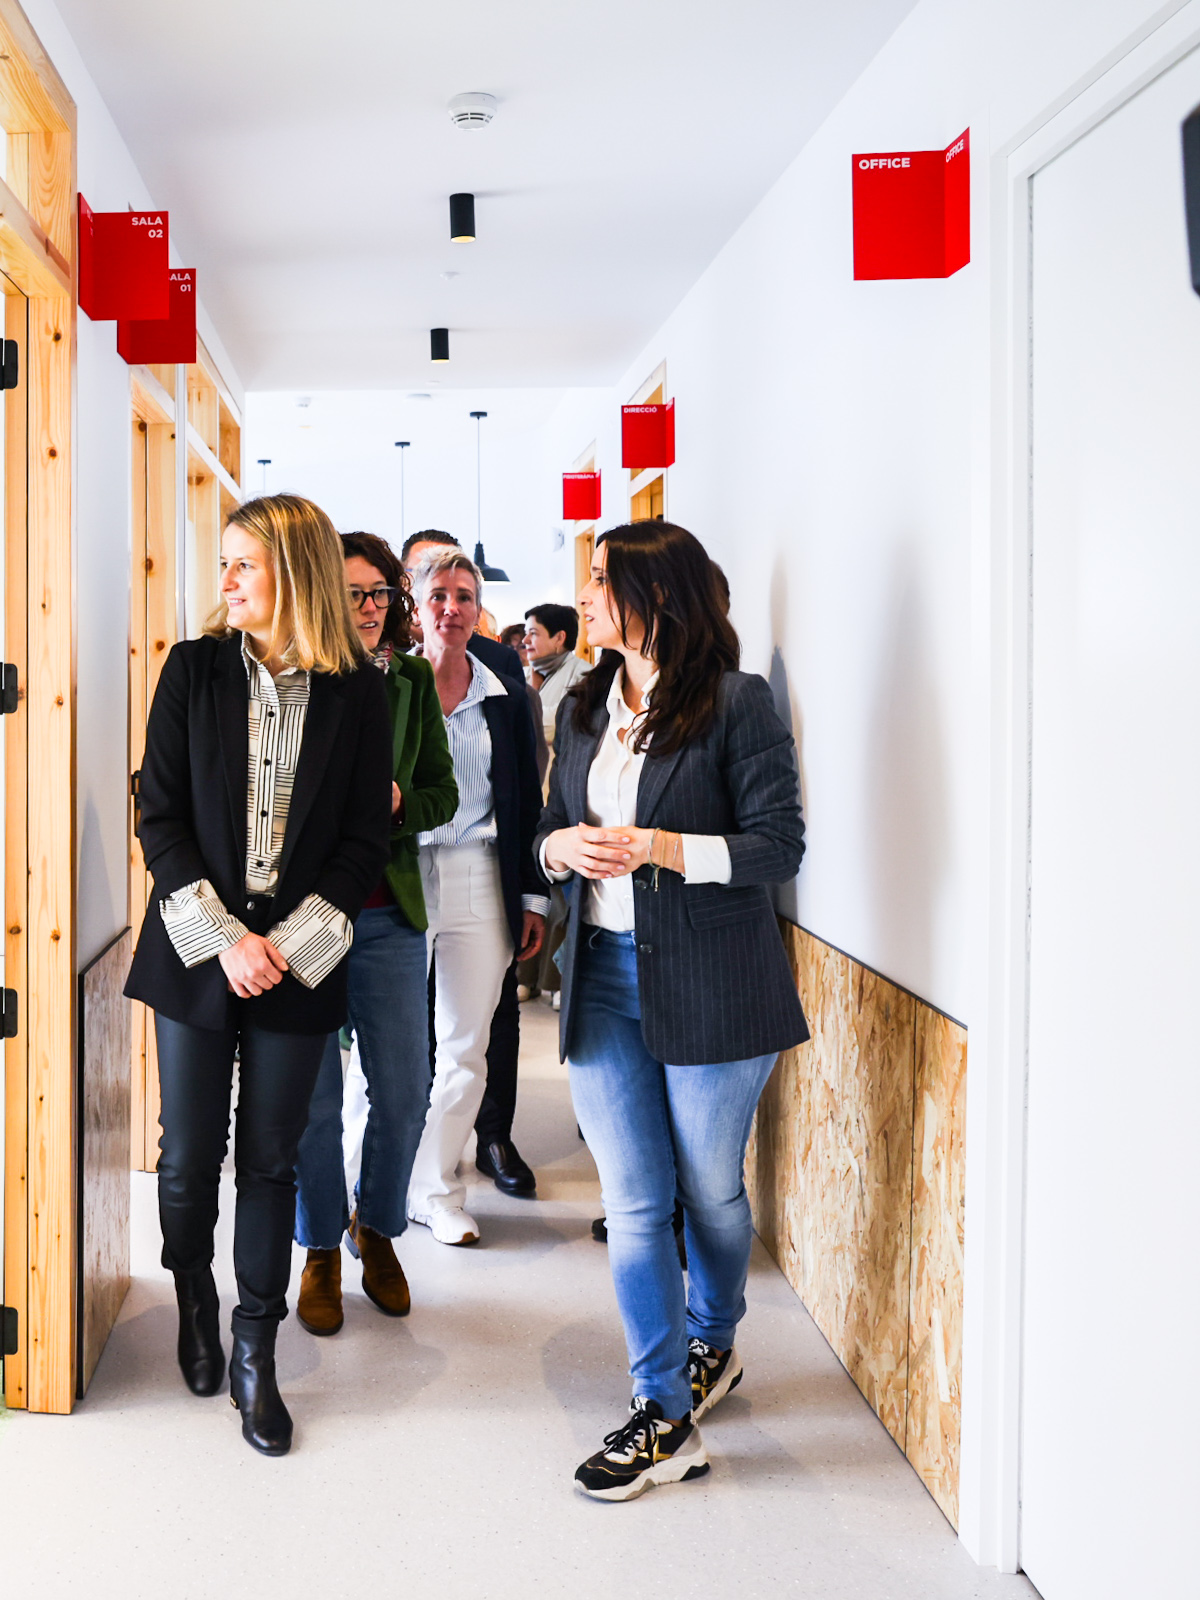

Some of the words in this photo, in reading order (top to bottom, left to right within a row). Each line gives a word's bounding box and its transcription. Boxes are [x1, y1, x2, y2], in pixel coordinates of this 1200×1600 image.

[945, 138, 964, 163] OFFICE
[859, 157, 911, 170] OFFICE
[131, 216, 163, 226] SALA
[148, 229, 163, 239] 02
[168, 273, 191, 281] ALA
[180, 284, 191, 292] 01
[623, 406, 658, 414] DIRECCIÓ
